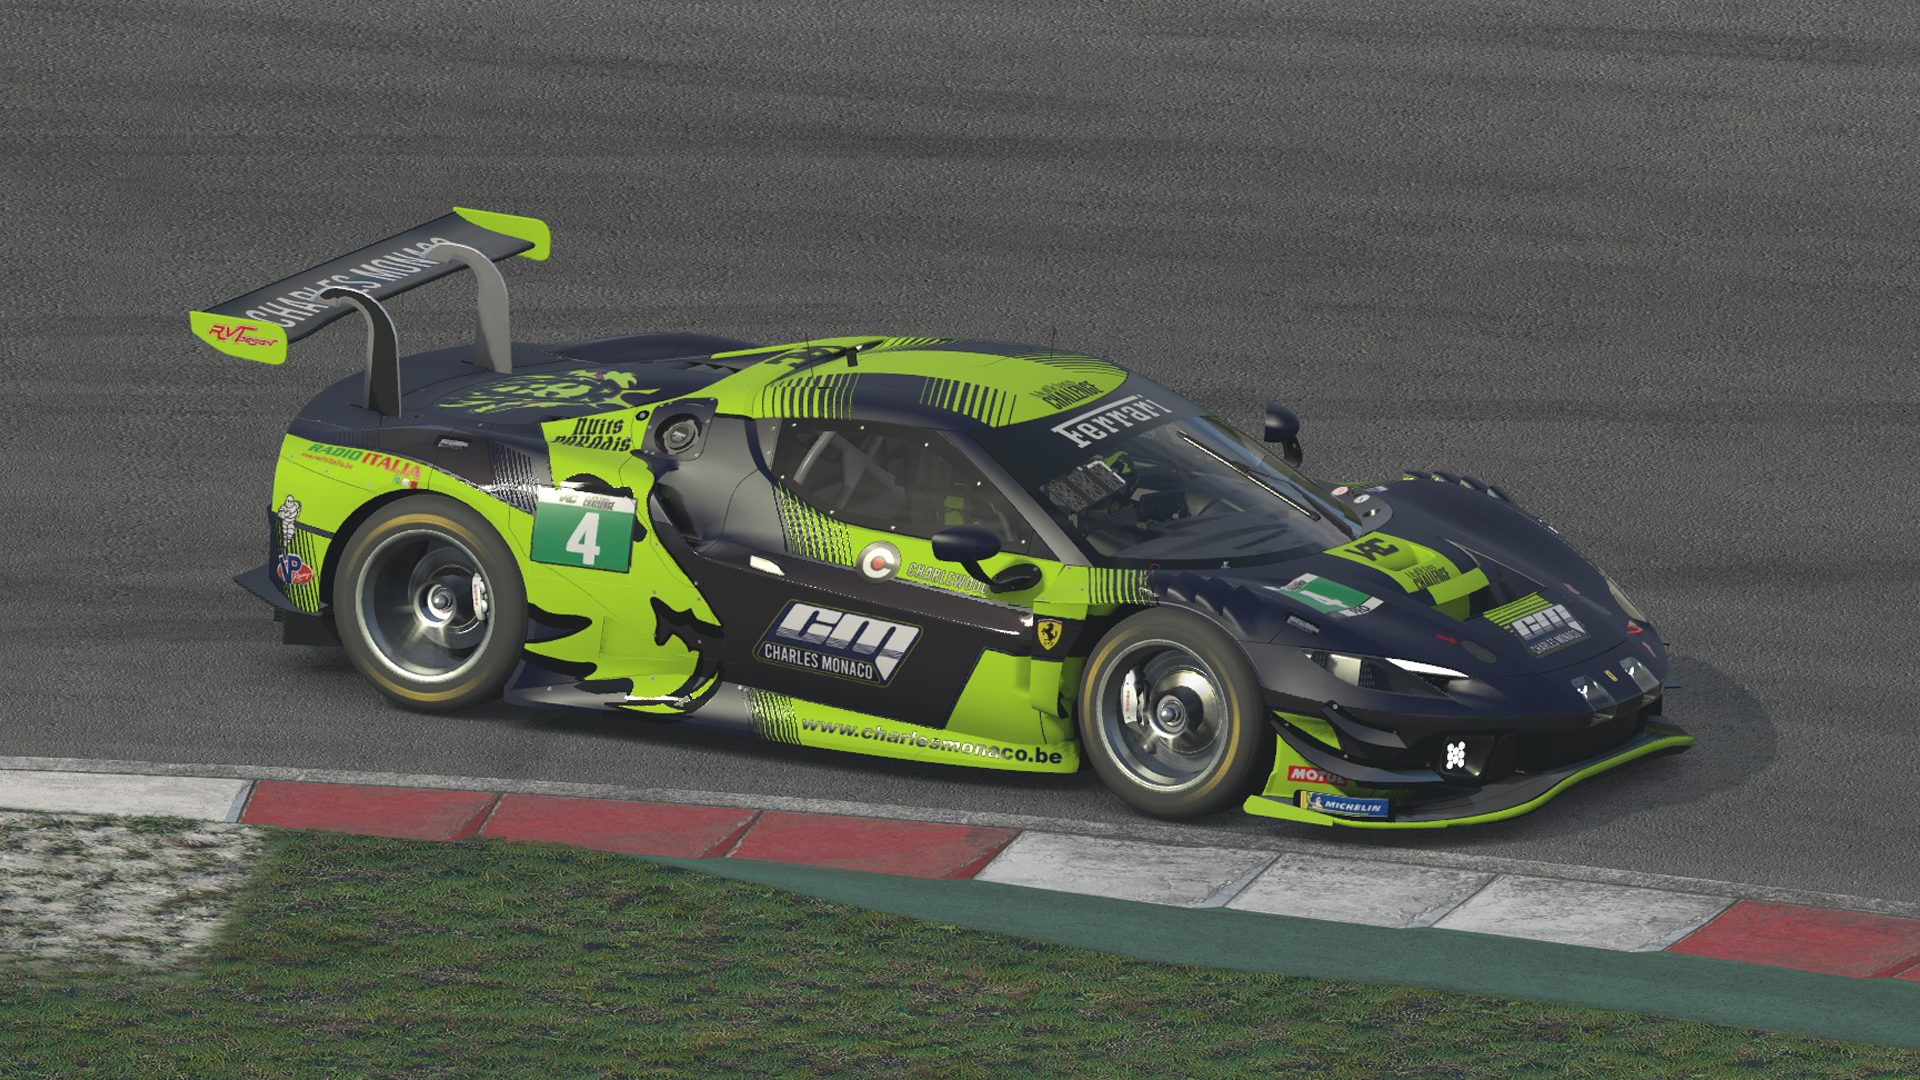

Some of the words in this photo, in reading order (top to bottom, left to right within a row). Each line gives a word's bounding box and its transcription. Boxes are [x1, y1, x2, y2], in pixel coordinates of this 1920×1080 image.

[1051, 394, 1172, 448] Ferrari
[308, 443, 363, 461] RADIO
[361, 451, 421, 480] ITALIA
[566, 511, 600, 566] 4
[278, 554, 302, 584] VP
[764, 643, 819, 668] CHARLES
[821, 656, 873, 680] MONACO
[802, 718, 1063, 765] www.charlesmonaco.be
[1325, 800, 1382, 812] MICHELIN
